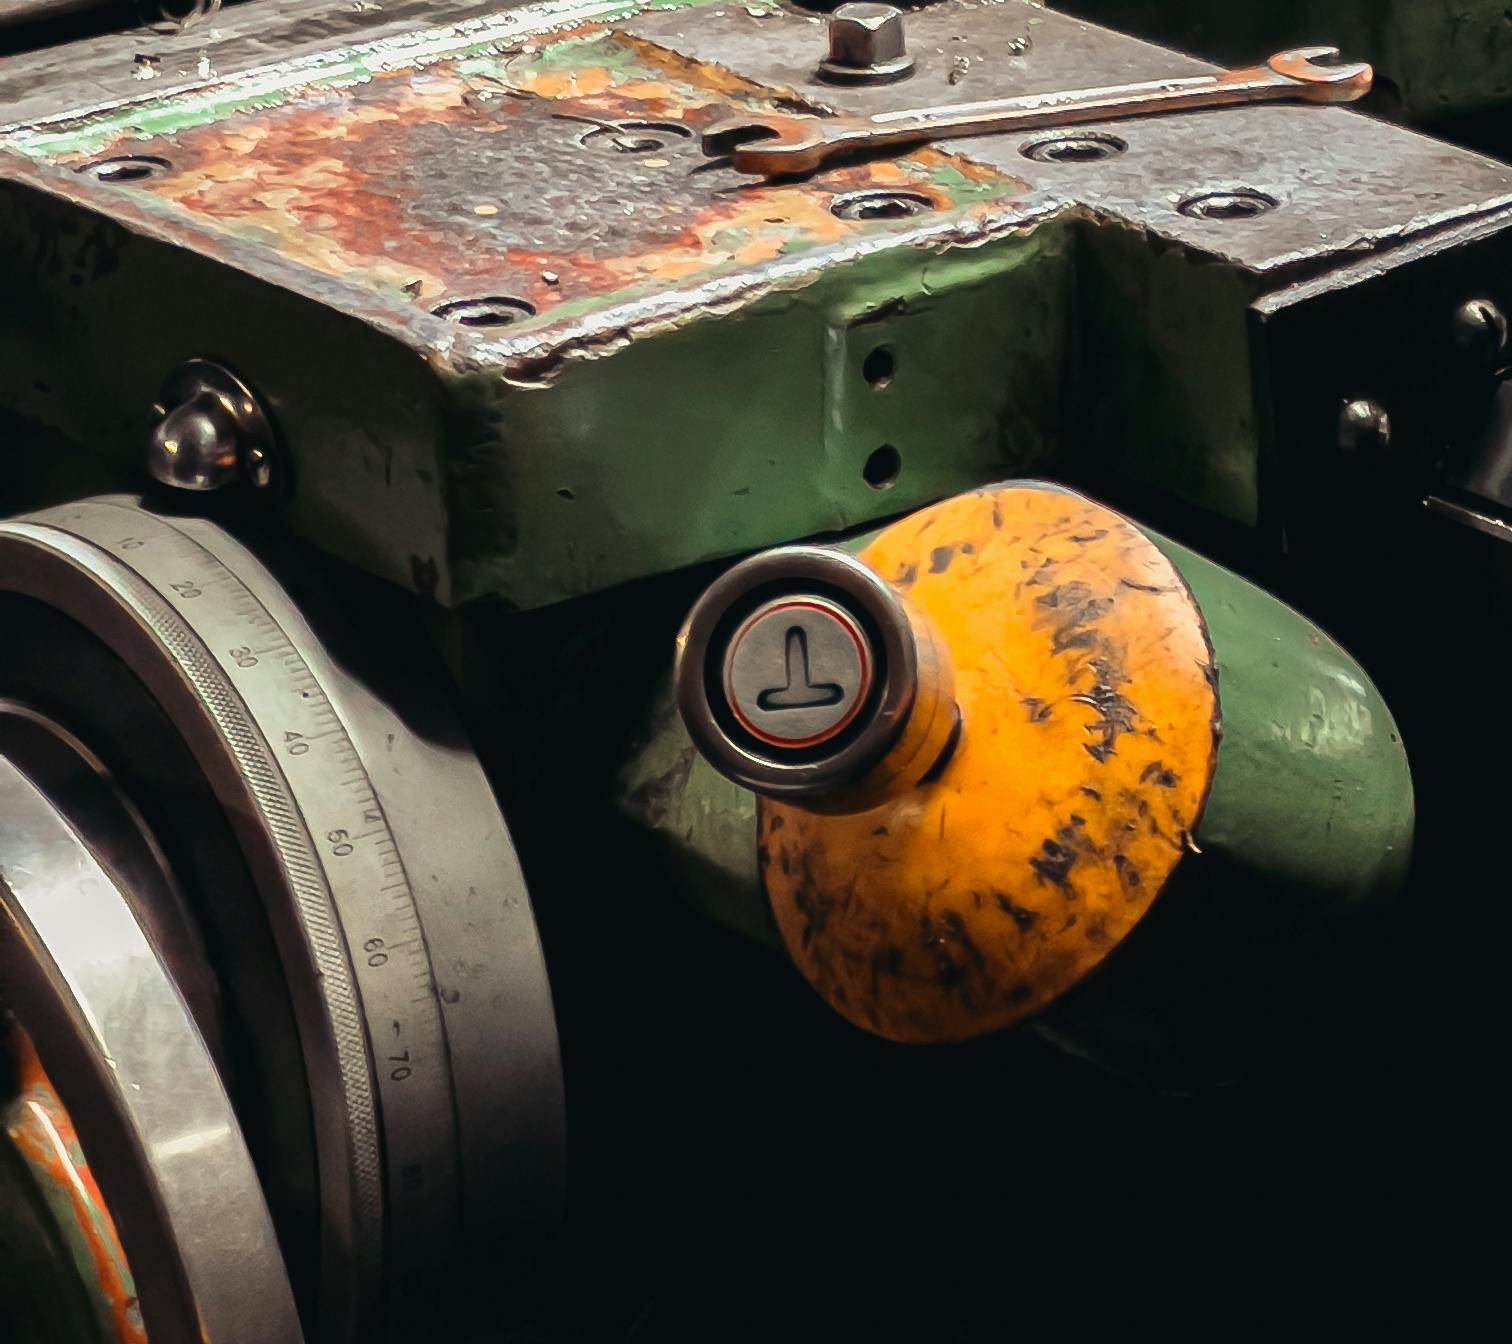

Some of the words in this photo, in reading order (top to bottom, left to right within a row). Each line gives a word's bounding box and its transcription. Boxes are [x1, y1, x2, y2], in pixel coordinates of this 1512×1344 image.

[116, 536, 145, 550] 10
[168, 580, 202, 599] 20
[229, 645, 259, 668] 30
[284, 730, 310, 756] 40
[326, 828, 354, 857] 50
[362, 937, 389, 968] 60
[388, 1050, 412, 1082] 70
